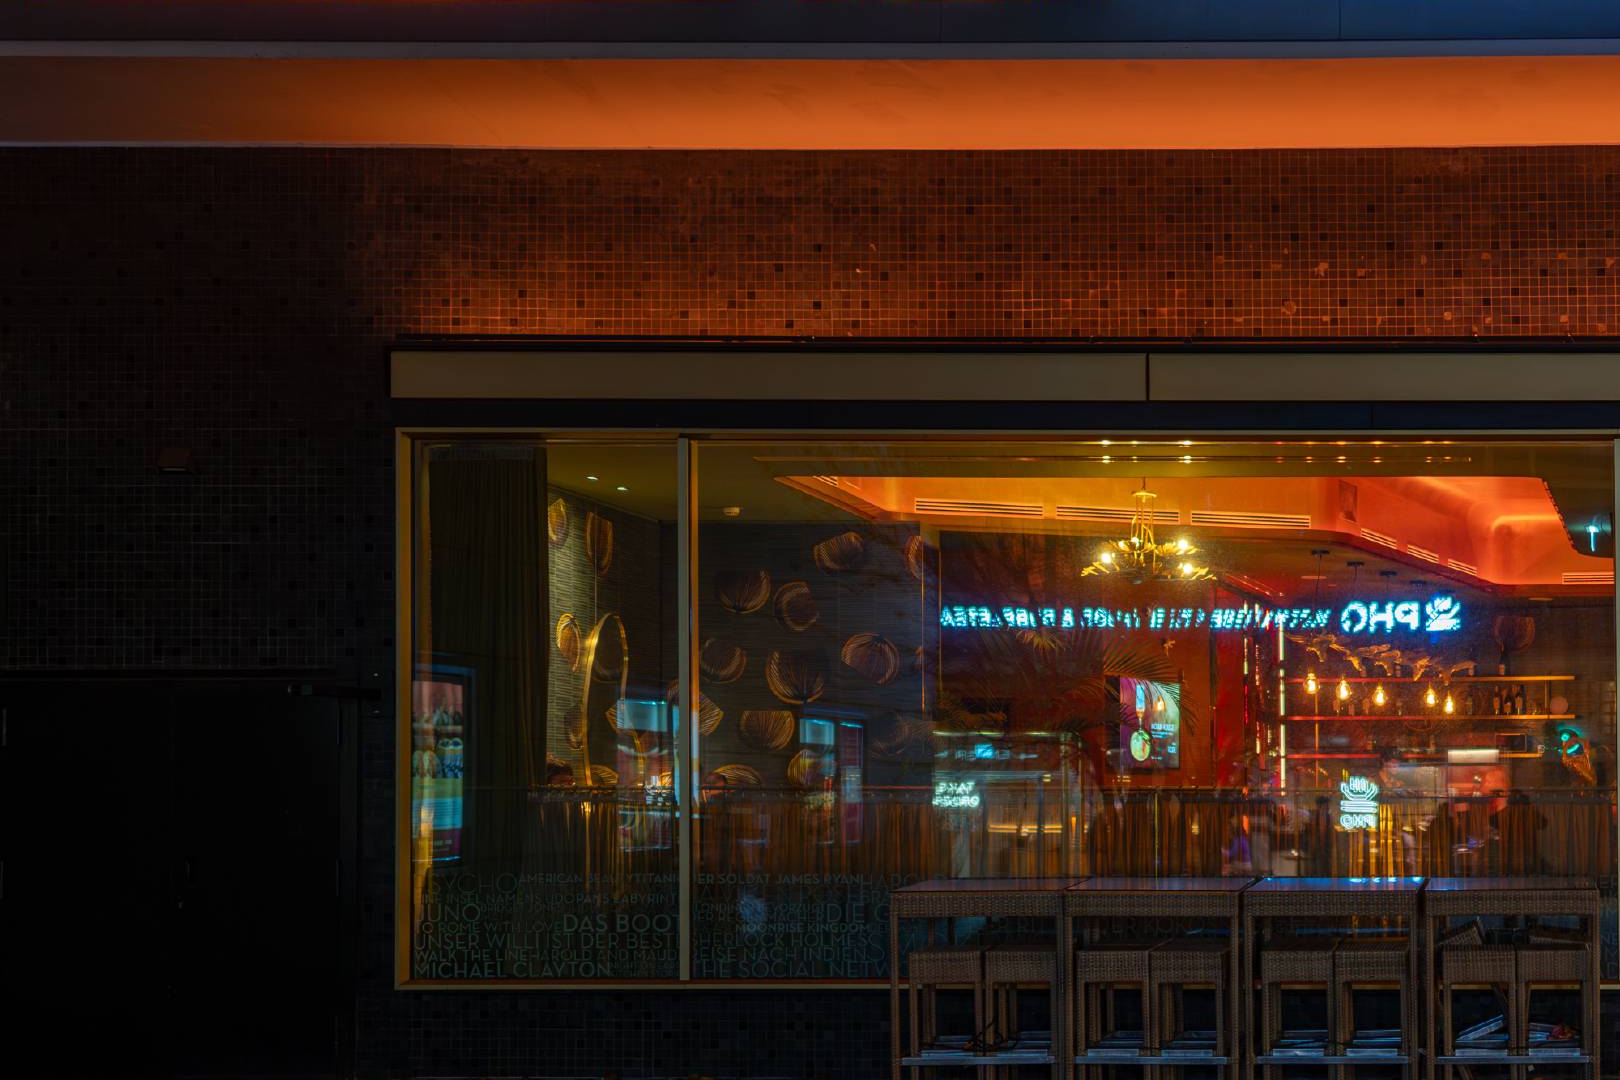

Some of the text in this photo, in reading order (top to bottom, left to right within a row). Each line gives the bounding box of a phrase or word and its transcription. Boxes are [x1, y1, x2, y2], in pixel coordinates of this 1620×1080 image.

[775, 873, 820, 885] JAMES
[614, 893, 679, 905] LABYRINT
[563, 914, 608, 933] DAS
[736, 922, 805, 934] MOONRISE
[807, 922, 870, 934] KINGDOM
[581, 933, 619, 949] DER
[462, 949, 491, 961] THE
[743, 946, 797, 962] NACH
[415, 962, 507, 979] MICHAEL
[513, 961, 611, 978] CLAYTON
[738, 961, 827, 978] SOCIAL
[829, 961, 891, 978] NETW
